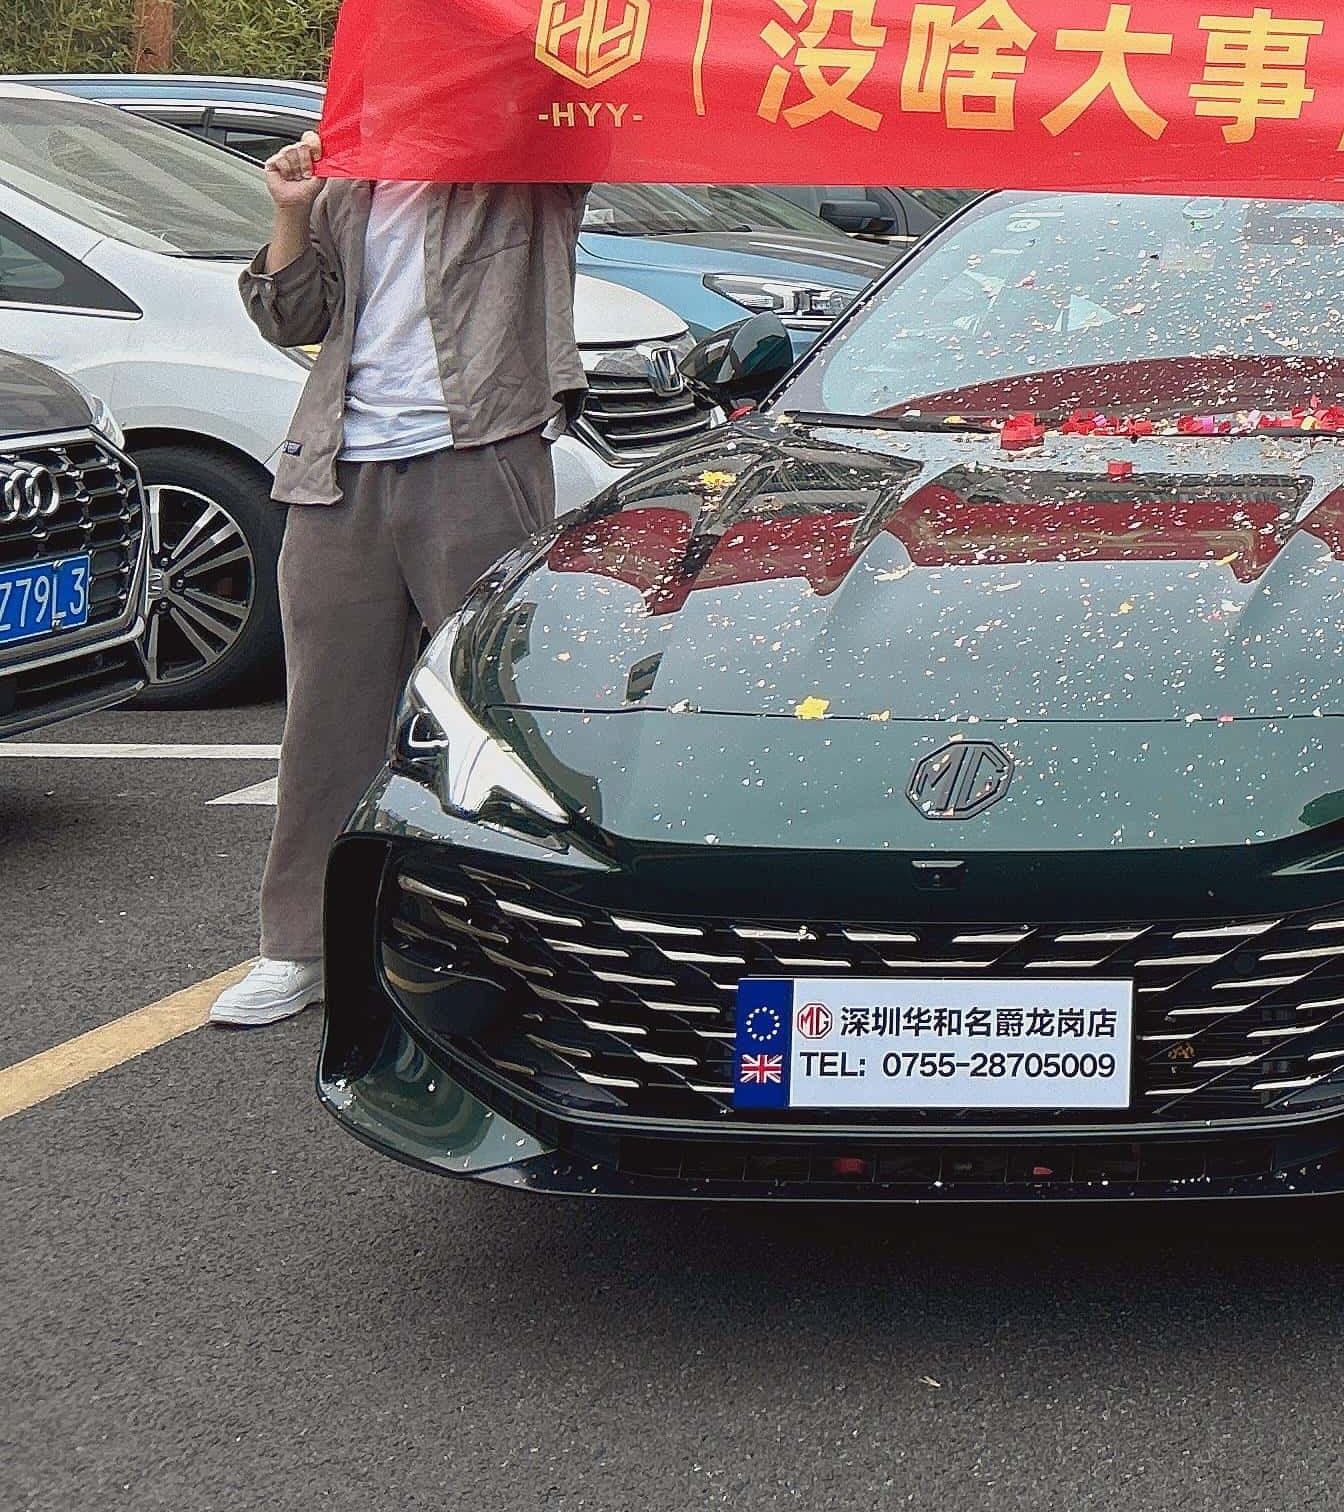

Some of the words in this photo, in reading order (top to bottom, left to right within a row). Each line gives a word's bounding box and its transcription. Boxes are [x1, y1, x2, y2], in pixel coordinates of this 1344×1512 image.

[912, 744, 1010, 816] MG
[841, 1006, 1117, 1039] 深圳华和名爵龙岗店
[800, 1052, 866, 1078] TEL:
[882, 1052, 1116, 1079] 0755-28705009
